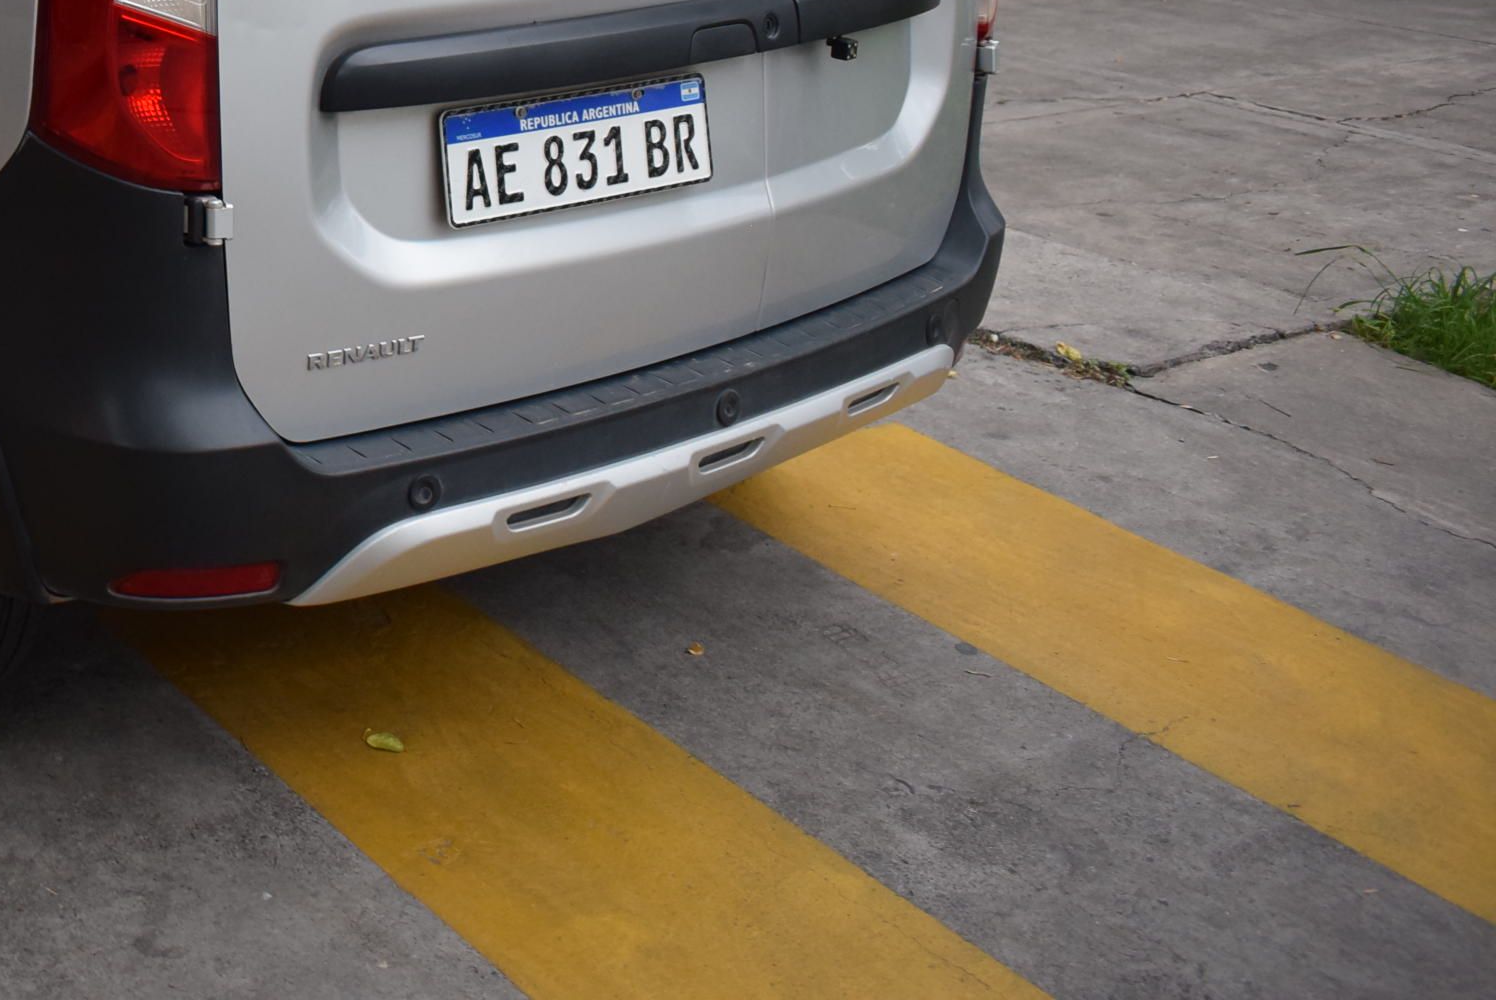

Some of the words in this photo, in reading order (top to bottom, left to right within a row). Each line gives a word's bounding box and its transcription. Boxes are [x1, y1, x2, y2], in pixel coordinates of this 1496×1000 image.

[520, 111, 579, 131] REPUBLICA
[582, 101, 640, 120] ARGENTINA
[465, 142, 525, 211] AE
[543, 126, 629, 196] 831
[644, 113, 700, 179] BR
[307, 335, 425, 371] RENAULT
